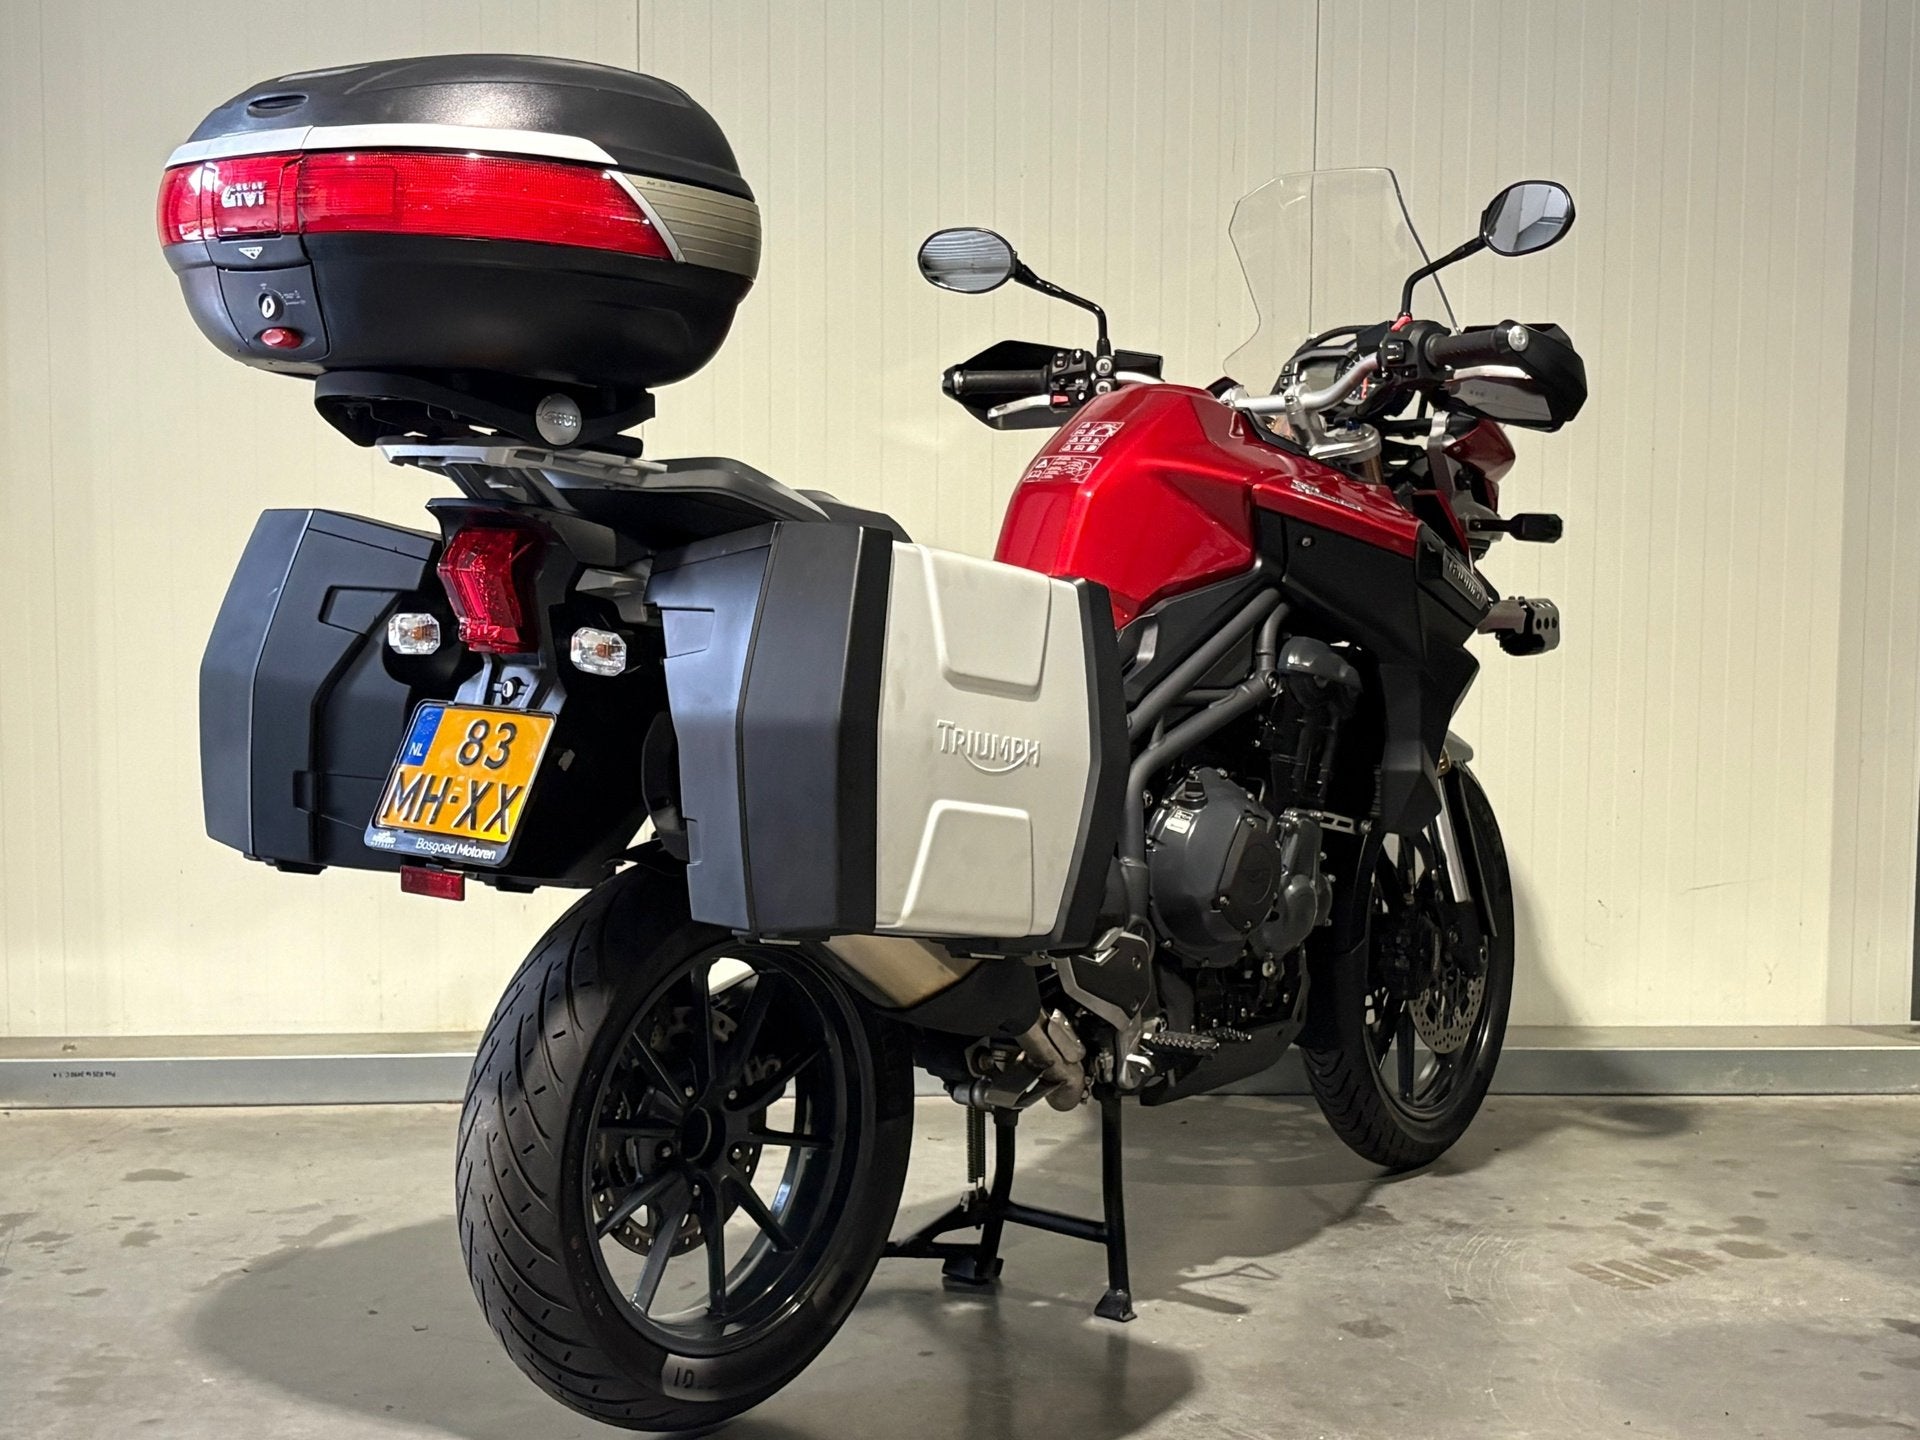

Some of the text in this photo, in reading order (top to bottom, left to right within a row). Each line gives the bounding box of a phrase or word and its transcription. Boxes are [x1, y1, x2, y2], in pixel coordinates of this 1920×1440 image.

[221, 182, 266, 208] GIVI
[408, 742, 423, 757] NL
[457, 719, 517, 770] 83
[937, 719, 1040, 769] TRIUMPH
[383, 772, 523, 835] MH-XX
[415, 837, 457, 855] Bosgoed
[456, 842, 497, 860] Motoren
